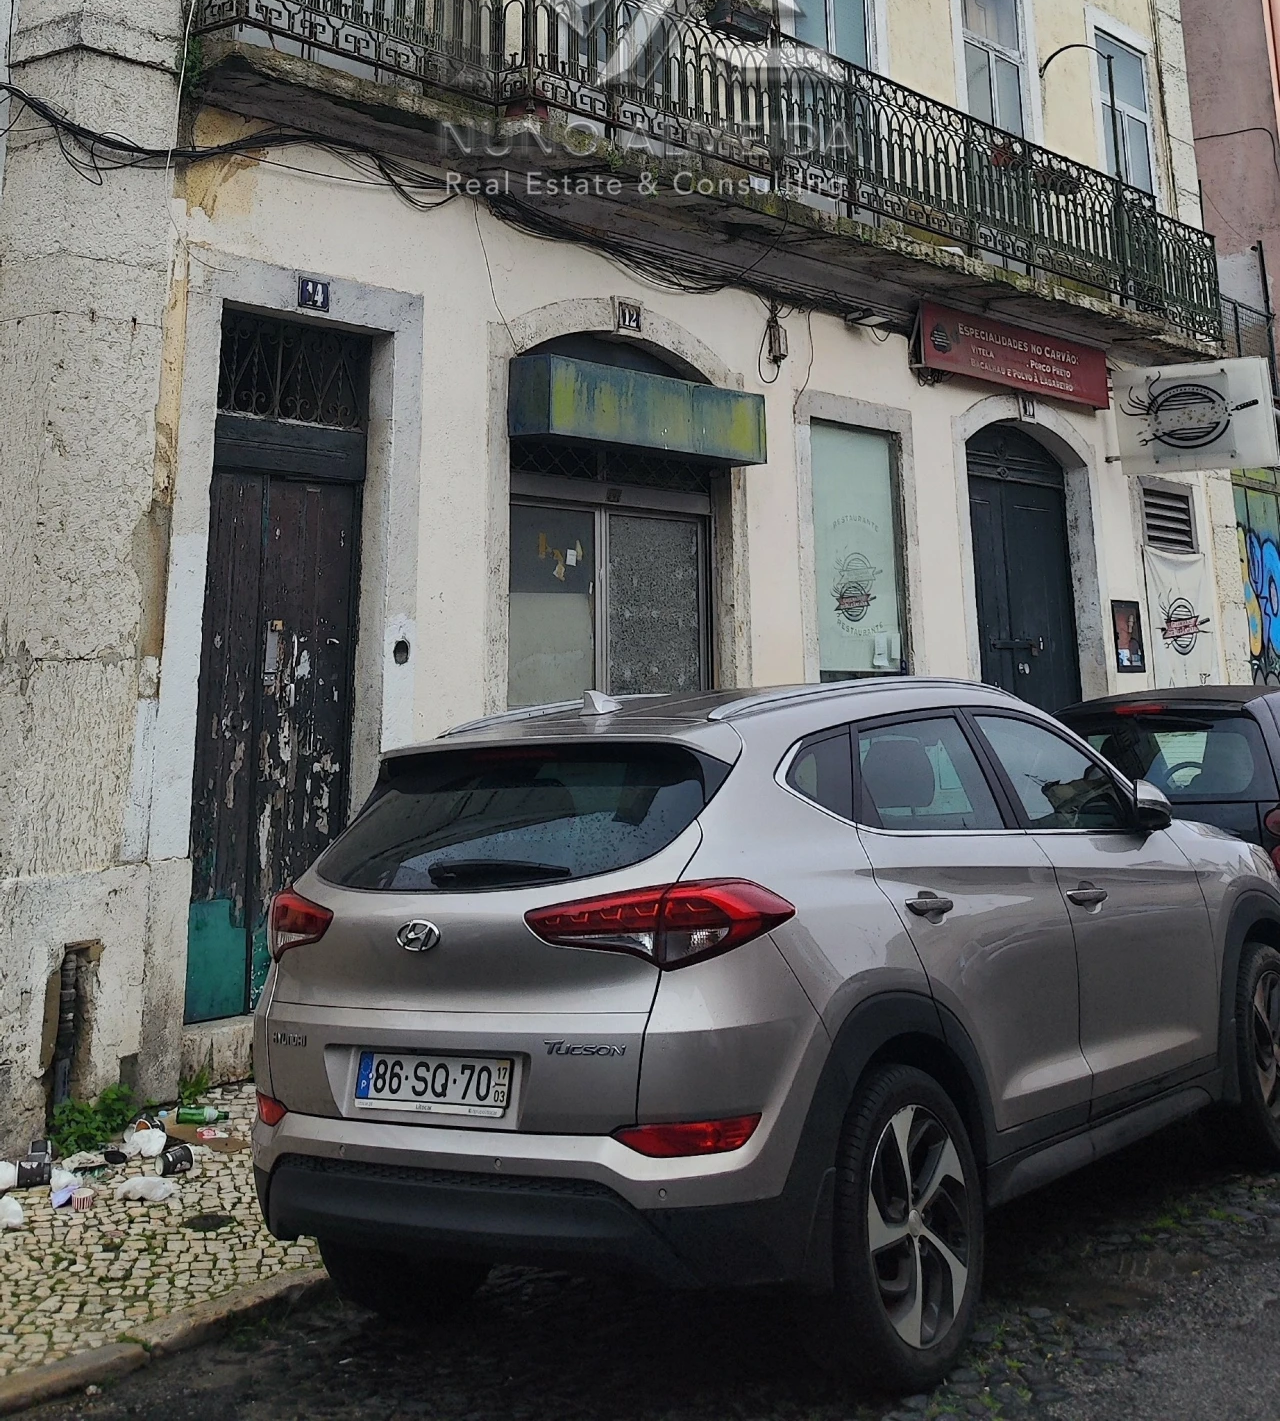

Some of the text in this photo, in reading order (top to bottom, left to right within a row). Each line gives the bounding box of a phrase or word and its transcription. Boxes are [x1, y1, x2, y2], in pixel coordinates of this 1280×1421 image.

[306, 281, 324, 306] 14
[624, 308, 637, 327] 12
[957, 322, 1029, 352] ESPECIALIDADES
[970, 344, 995, 359] VITELA
[833, 515, 879, 533] RESTAURANTE
[837, 619, 884, 636] RESTAURANTE
[543, 1039, 627, 1057] TUCSON
[497, 1066, 508, 1080] 17
[493, 1090, 505, 1103] 03
